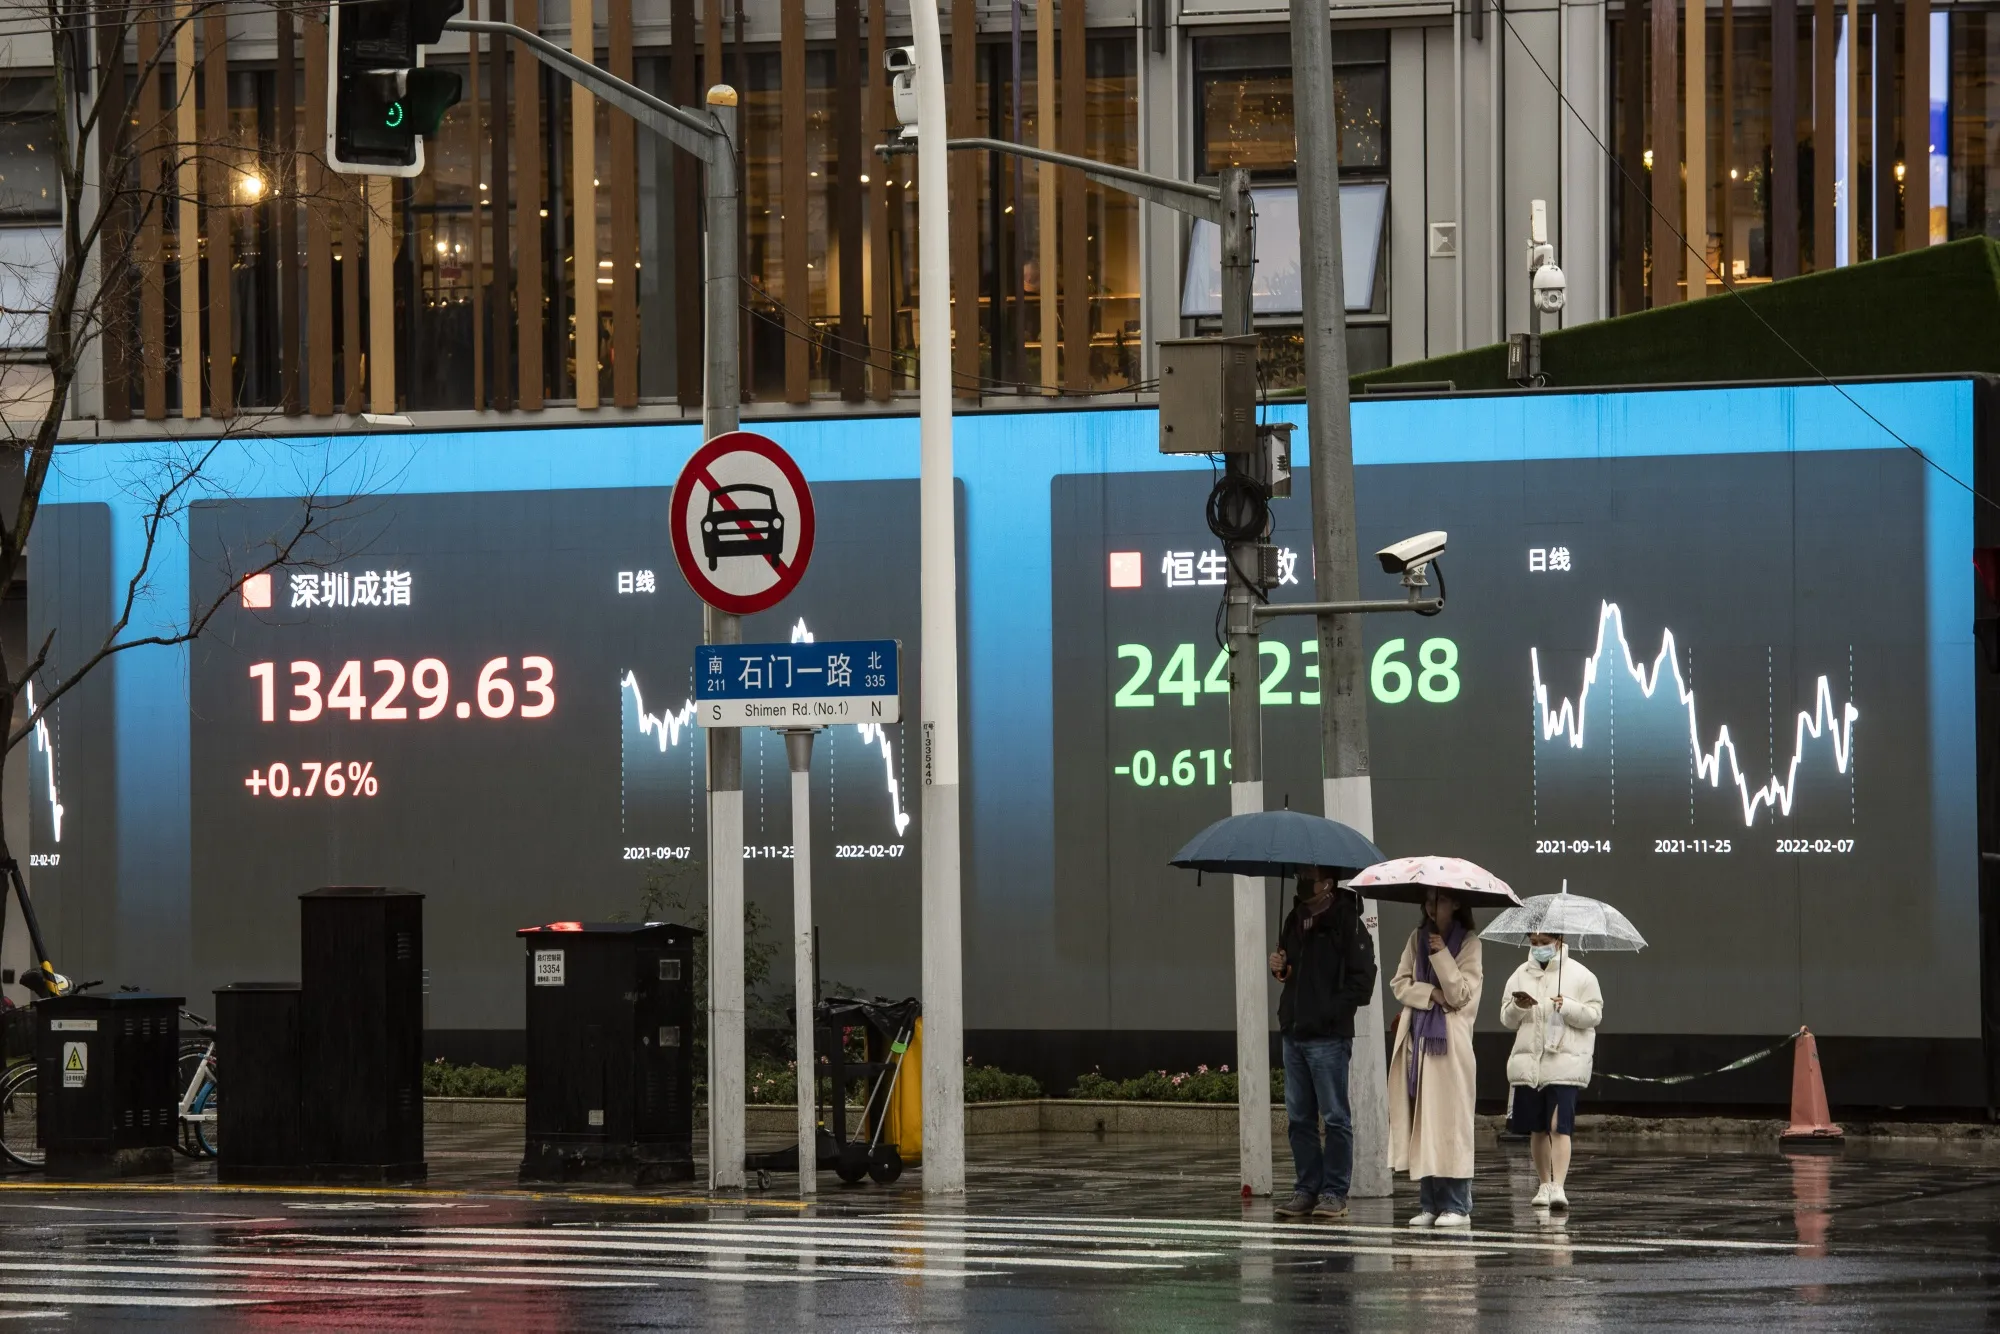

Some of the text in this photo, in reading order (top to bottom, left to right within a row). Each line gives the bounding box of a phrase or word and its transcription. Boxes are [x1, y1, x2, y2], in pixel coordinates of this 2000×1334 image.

[1162, 548, 1299, 588] 恒生数
[1530, 547, 1572, 572] 日线
[291, 571, 411, 608] 深圳成指
[618, 570, 656, 594] 日线
[709, 656, 723, 675] 南
[867, 651, 882, 670] 北
[738, 652, 853, 690] 石门一路
[1115, 637, 1461, 707] 2442368
[250, 656, 555, 722] 13429.63
[707, 679, 725, 692] 211
[865, 674, 886, 688] 335
[712, 705, 722, 721] S
[745, 703, 787, 718] Shimen
[871, 701, 882, 717] N
[925, 730, 933, 786] 1335440
[1114, 748, 1233, 787] -0.61
[245, 761, 378, 797] +0.76%
[623, 846, 691, 860] 2021-09-07
[743, 845, 795, 859] 21-11-23
[835, 844, 905, 858] 2022-02-07
[1536, 839, 1612, 854] 2021-09-14
[1654, 839, 1732, 853] 2021-11-25
[1775, 839, 1855, 853] 2022-02-07
[538, 964, 561, 974] 13354
